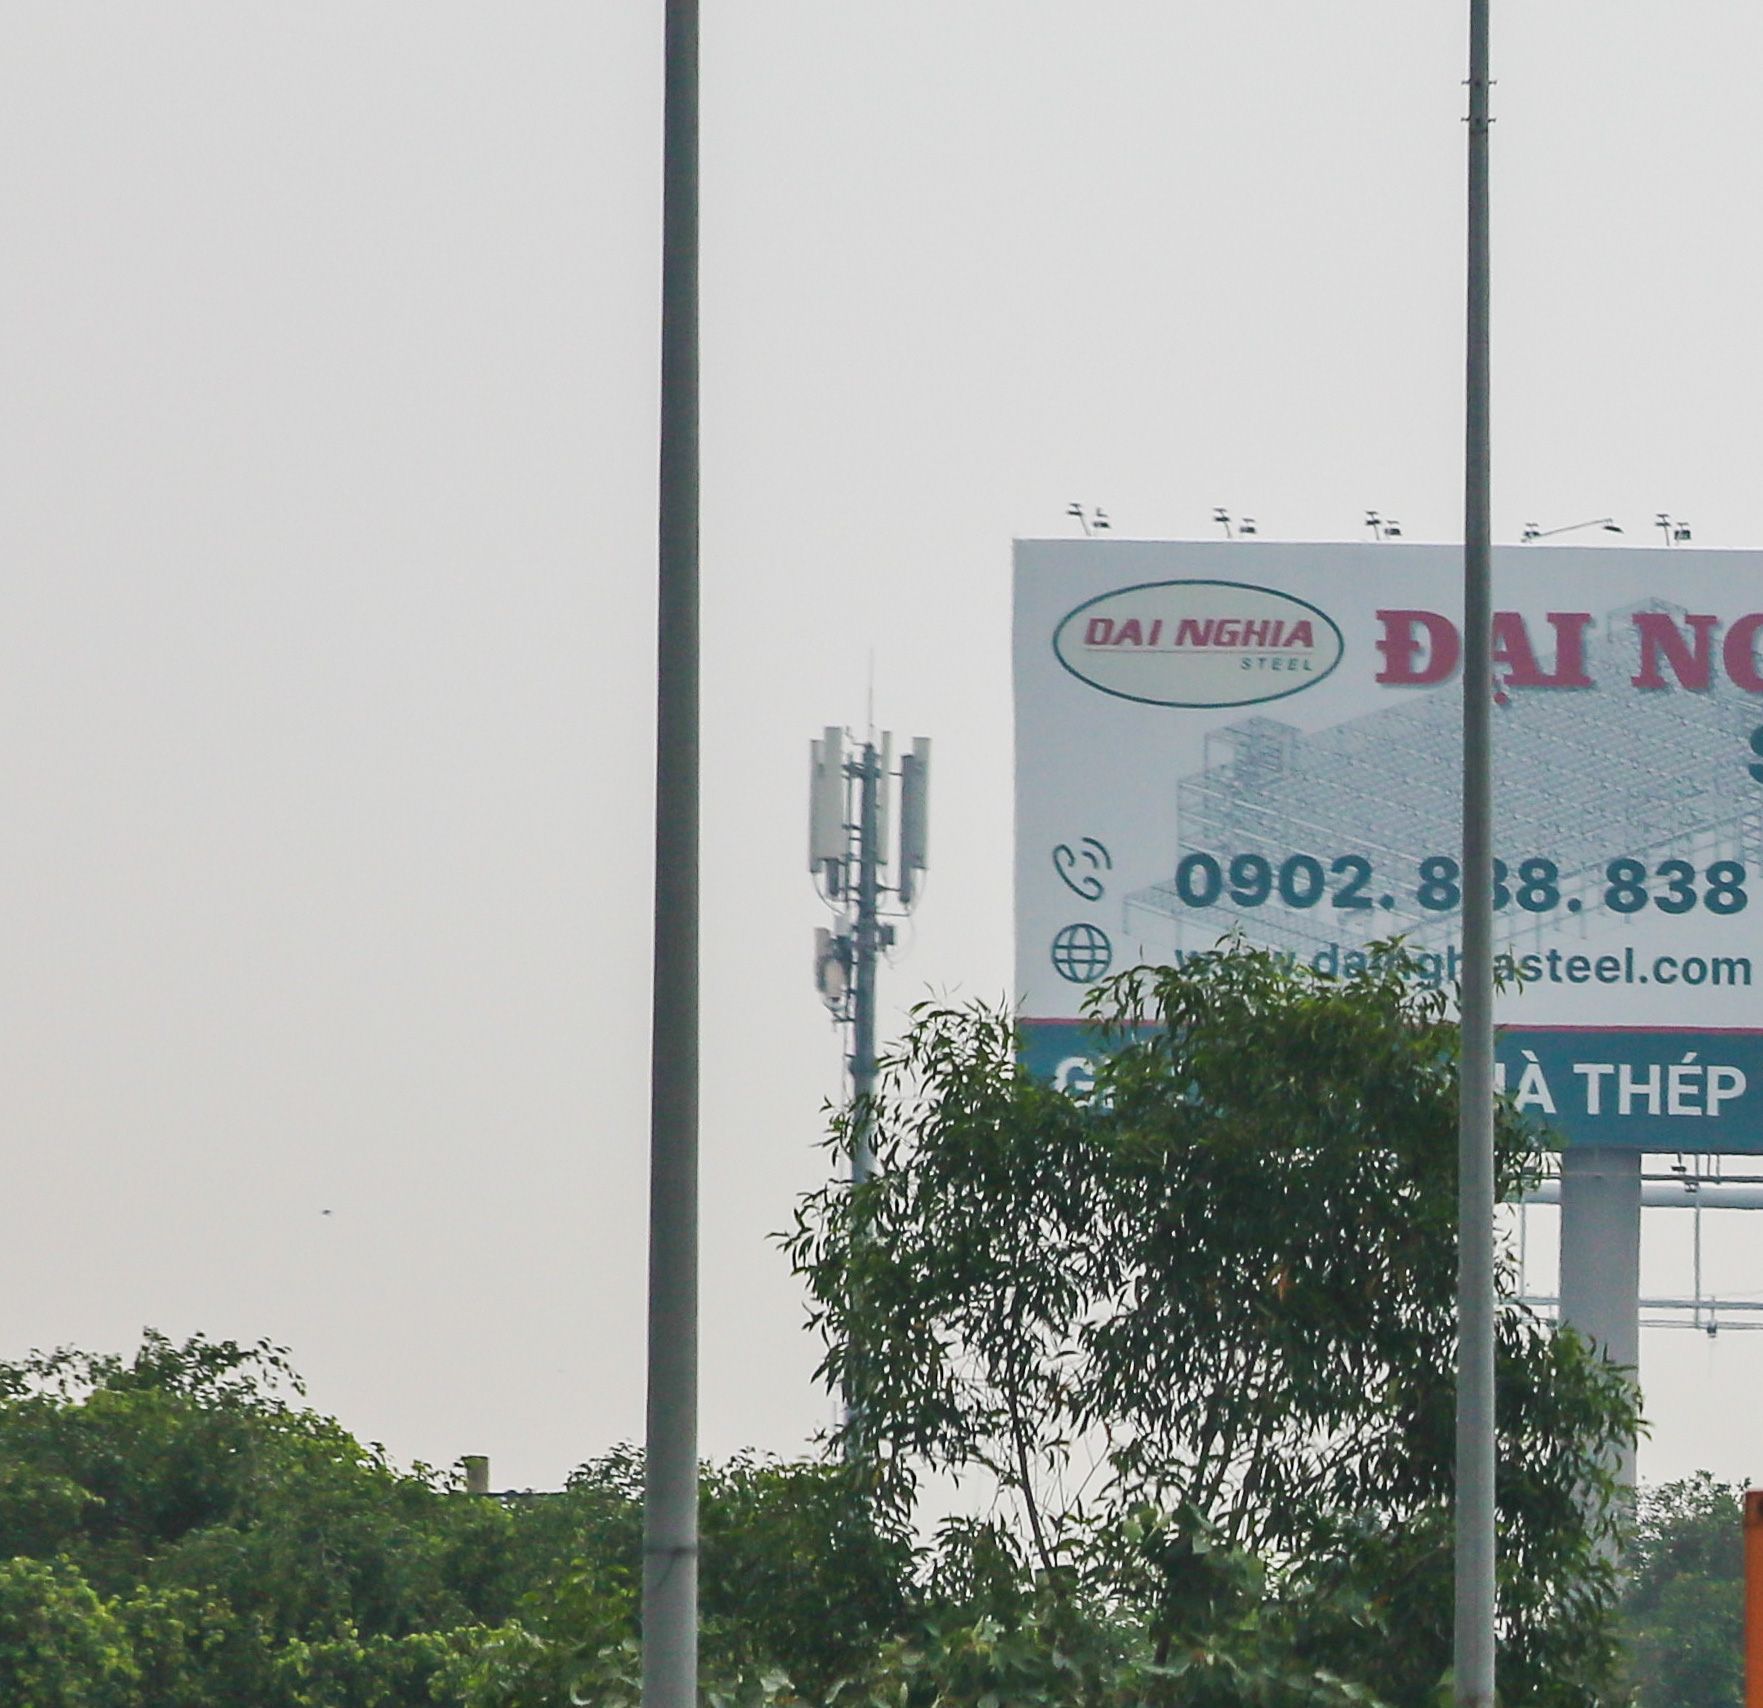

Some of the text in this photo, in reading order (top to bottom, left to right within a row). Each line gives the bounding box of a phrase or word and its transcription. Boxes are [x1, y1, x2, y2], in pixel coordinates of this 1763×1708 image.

[1083, 617, 1315, 649] DAI NGHIA
[1240, 657, 1314, 672] STEEL
[1574, 1053, 1747, 1117] THÉP
